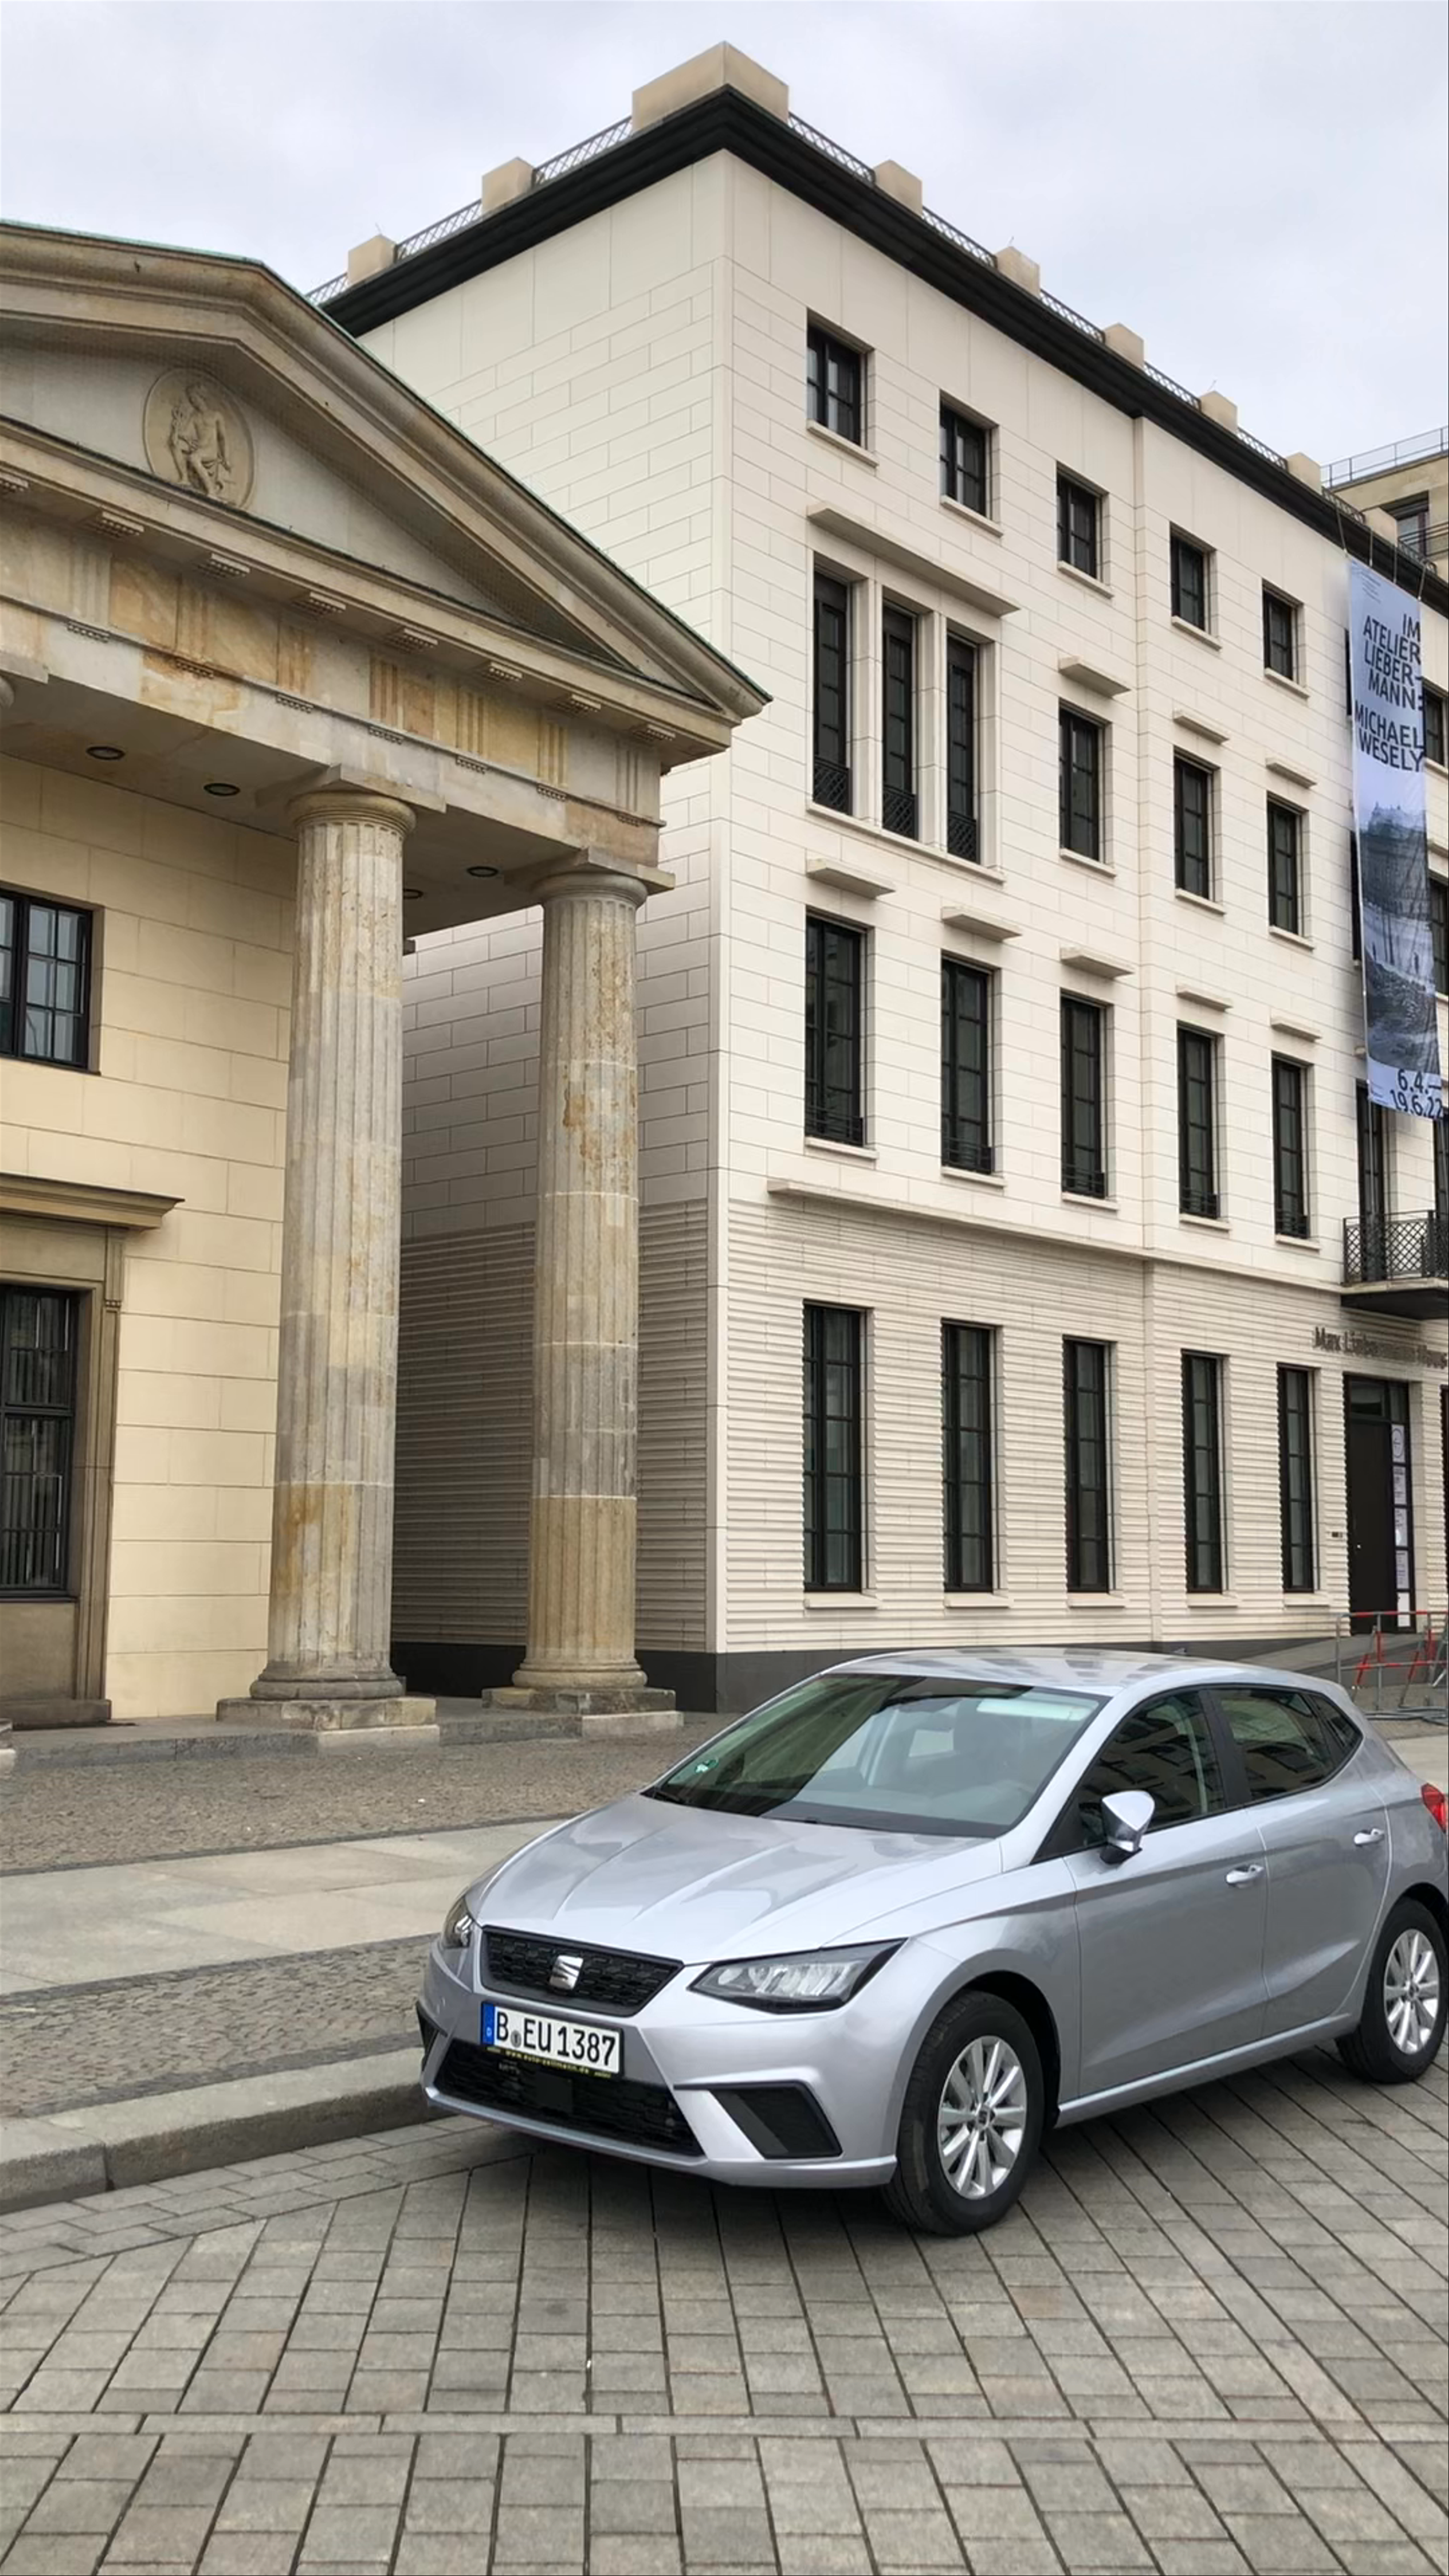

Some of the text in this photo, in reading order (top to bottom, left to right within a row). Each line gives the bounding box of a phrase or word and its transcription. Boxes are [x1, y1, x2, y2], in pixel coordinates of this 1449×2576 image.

[1363, 615, 1421, 665] ATELIER
[1403, 614, 1421, 642] IM
[1365, 640, 1422, 687] LIEBER-
[1355, 700, 1424, 749] MICHAEL
[1359, 728, 1424, 772] WESELY
[496, 2012, 509, 2041] B
